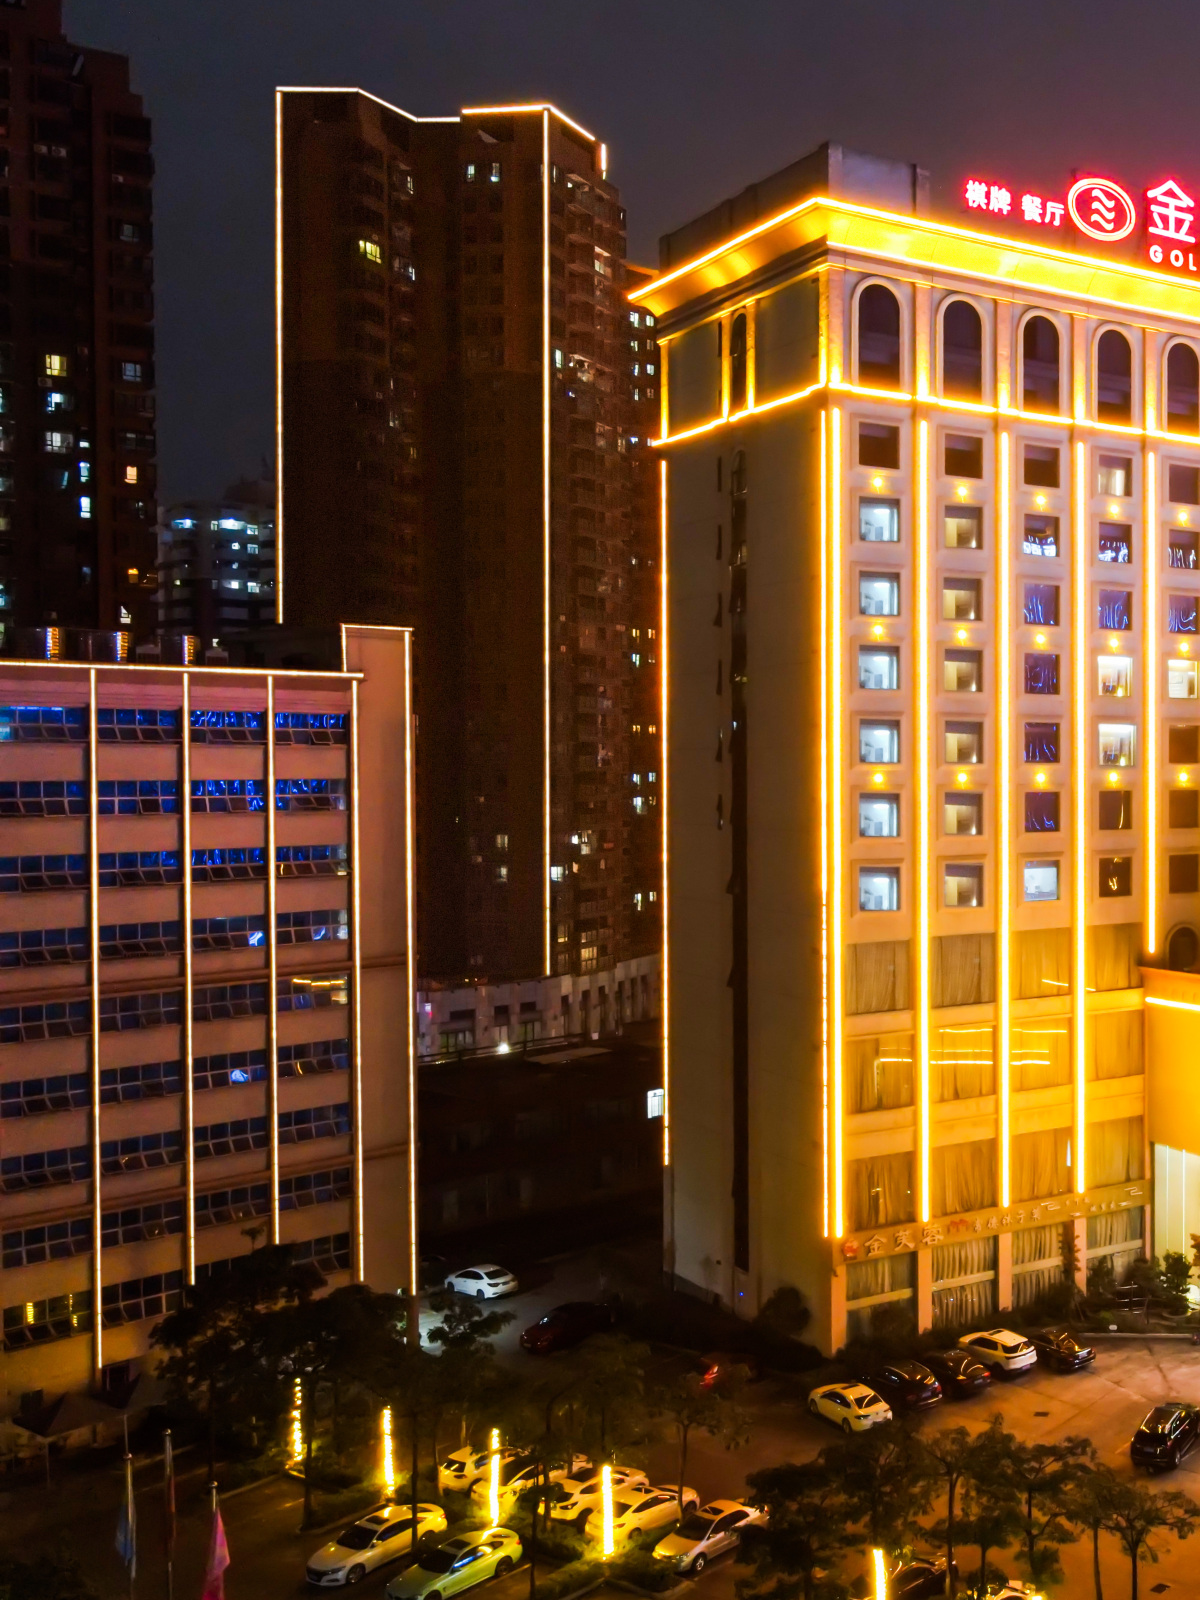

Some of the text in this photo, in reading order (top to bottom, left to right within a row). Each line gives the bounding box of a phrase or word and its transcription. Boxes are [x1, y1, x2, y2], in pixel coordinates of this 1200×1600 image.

[965, 180, 1065, 226] 棋牌 餐厅
[864, 1225, 945, 1257] 金芙蓉
